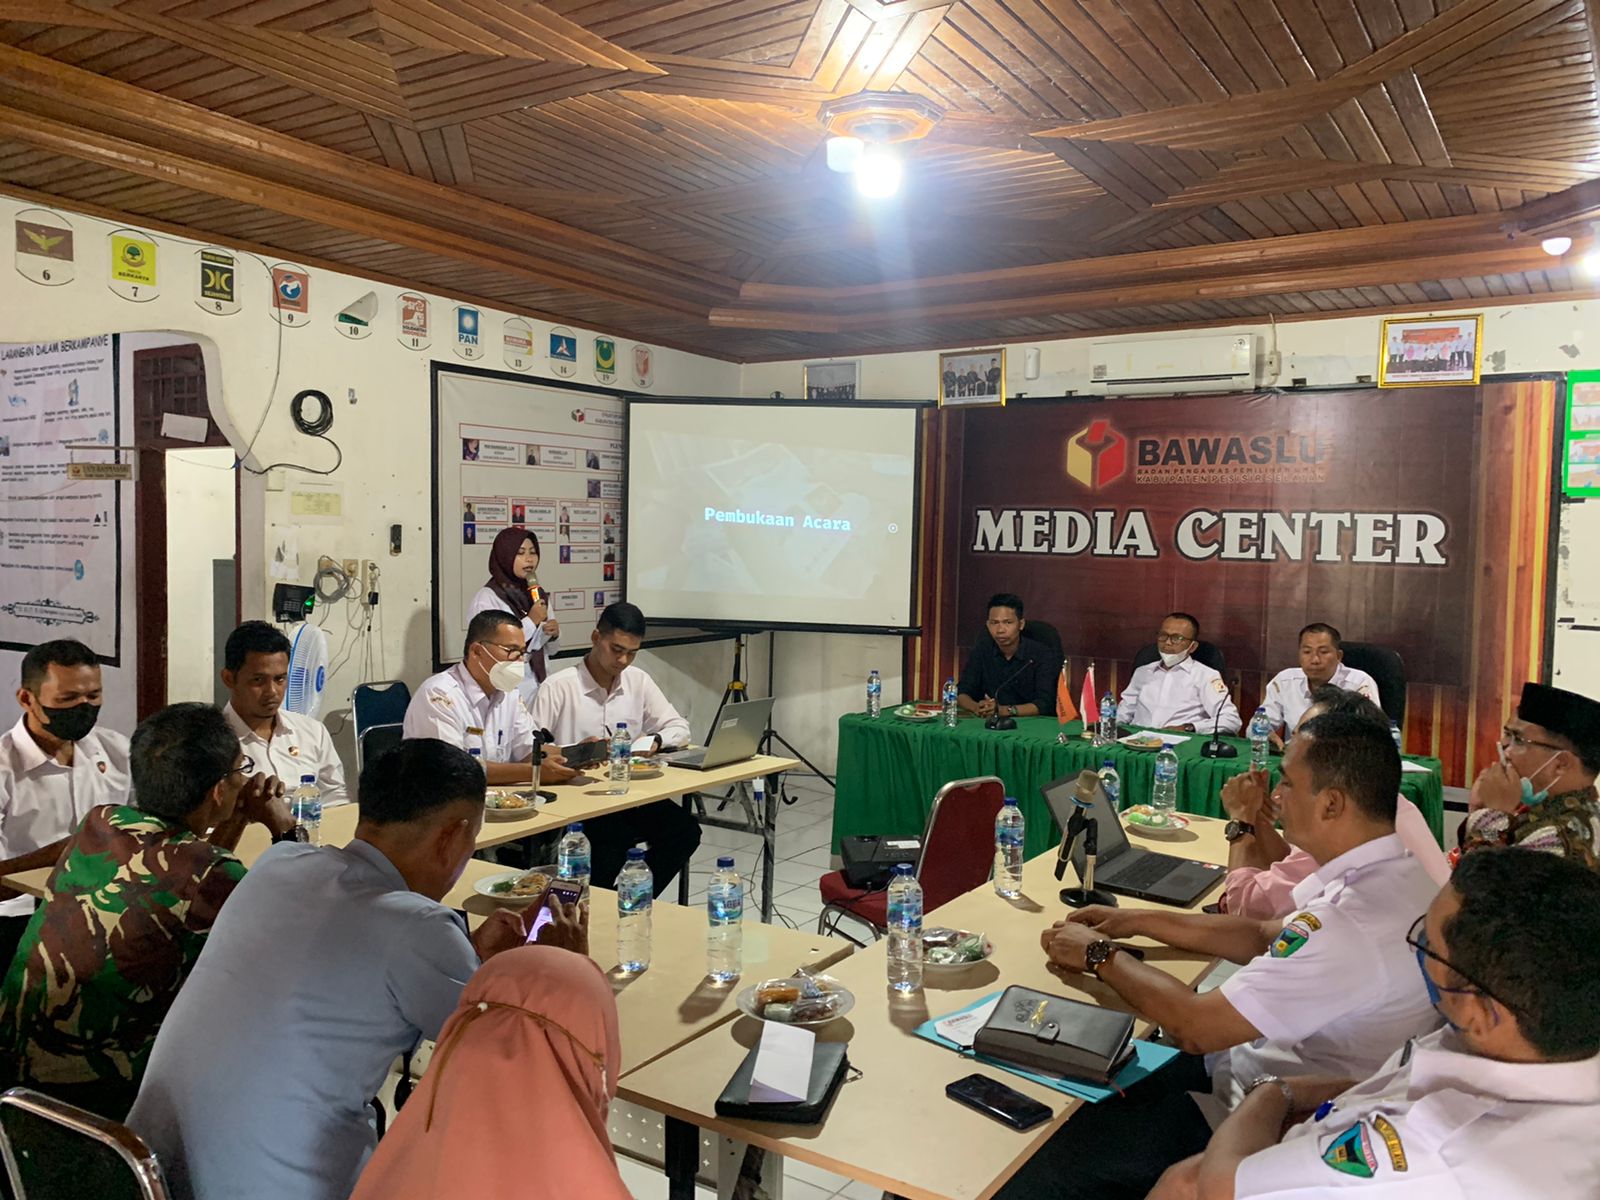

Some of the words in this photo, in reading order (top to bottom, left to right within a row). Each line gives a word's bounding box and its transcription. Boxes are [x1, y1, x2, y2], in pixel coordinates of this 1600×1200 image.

[42, 269, 51, 281] 6
[131, 286, 139, 297] 7
[215, 301, 222, 311] 8
[287, 313, 294, 323] 9
[349, 326, 359, 336] 10
[411, 338, 419, 347] 11
[458, 333, 479, 345] PAN
[464, 347, 473, 357] 12
[514, 359, 522, 368] 13
[560, 365, 567, 374] 14
[602, 373, 610, 382] 19
[1138, 435, 1327, 466] BAWASLU
[1136, 474, 1207, 484] KABUPATEN
[1211, 474, 1263, 483] PESISIR
[1266, 474, 1326, 483] SELATAN
[704, 507, 795, 527] Pembukaan
[802, 515, 852, 531] Acara
[972, 508, 1159, 558] MEDIA
[1175, 508, 1448, 565] CENTER
